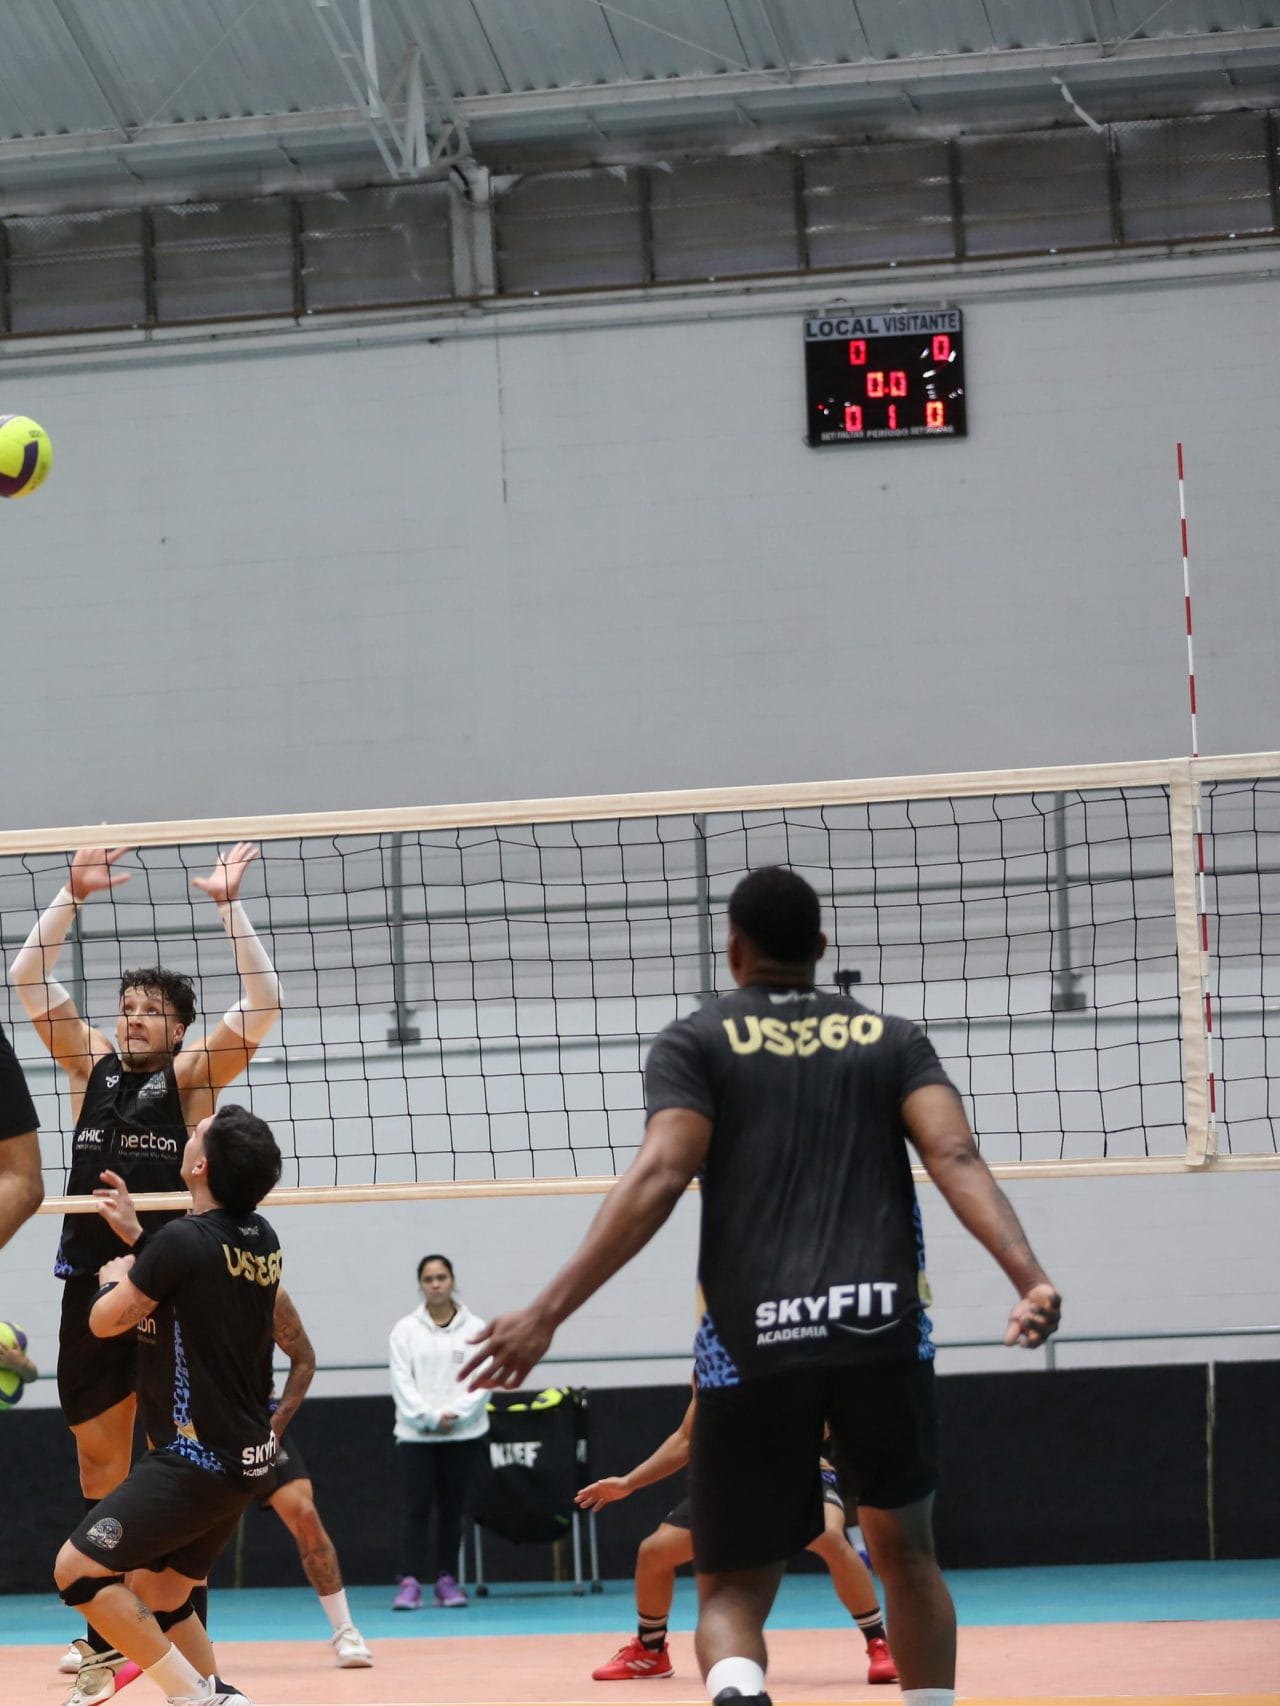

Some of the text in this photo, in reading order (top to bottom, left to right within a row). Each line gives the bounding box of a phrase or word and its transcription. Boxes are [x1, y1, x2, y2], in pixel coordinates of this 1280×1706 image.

[806, 312, 956, 337] LOCAL VISITANTE
[849, 339, 866, 365] 0
[932, 335, 950, 361] 0
[845, 405, 862, 431] 0
[888, 404, 896, 429] 1
[926, 401, 943, 427] 0
[120, 1132, 177, 1152] necton
[755, 1282, 897, 1328] SKYFIT
[756, 1325, 828, 1346] ACADEMIA
